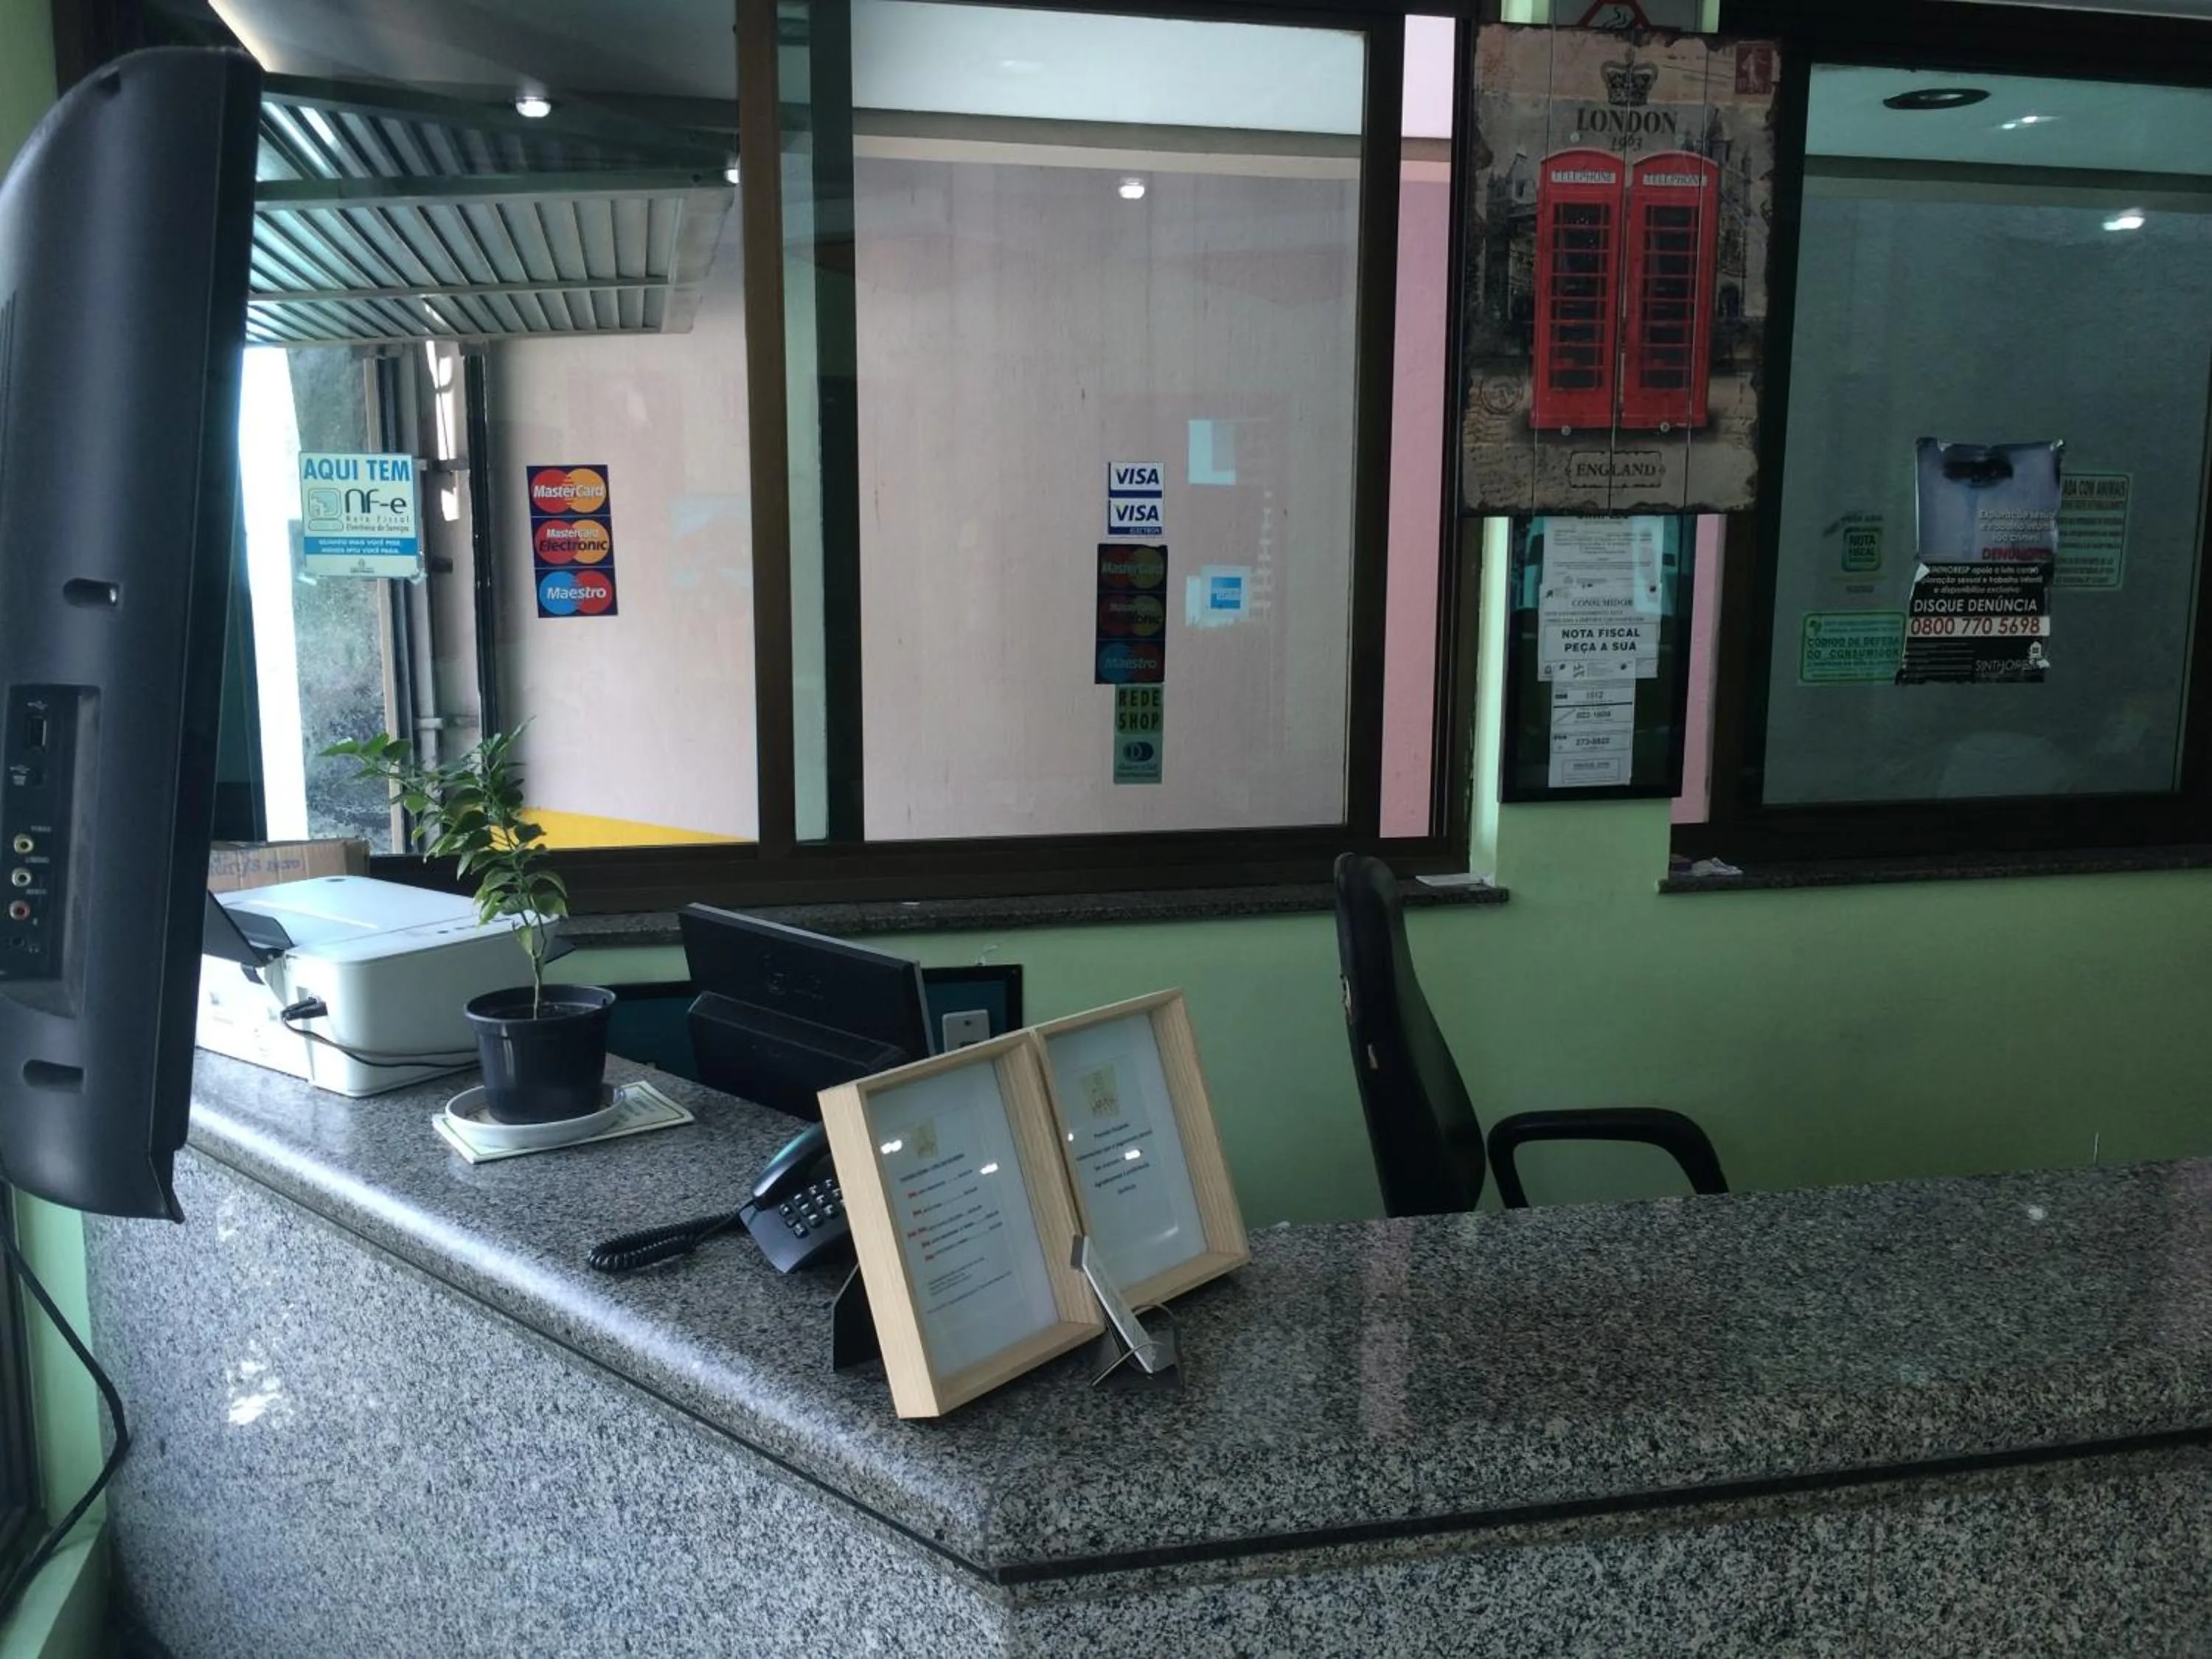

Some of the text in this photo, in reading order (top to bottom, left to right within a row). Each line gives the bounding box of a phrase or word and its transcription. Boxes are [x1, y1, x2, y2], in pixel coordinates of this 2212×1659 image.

[1576, 108, 1677, 135] LONDON
[1554, 171, 1612, 182] TELEPHONE
[303, 458, 411, 481] AQUI TEM
[1116, 468, 1160, 484] VISA
[1576, 462, 1656, 477] ENGLAND
[533, 484, 605, 499] MasterCard
[1116, 505, 1160, 521] VISA
[539, 538, 608, 552] Electronic
[546, 586, 607, 599] Maestro
[1914, 595, 2037, 614] DISQUE DENÚNCIA
[1561, 627, 1641, 639] NOTA FISCAL
[1911, 617, 1955, 635] 0800
[1962, 617, 1993, 635] 770
[1998, 616, 2040, 635] 5698
[1564, 641, 1637, 653] PEÇA A SUA
[1104, 658, 1157, 669] Maestro
[1119, 689, 1161, 706] REDE
[1119, 712, 1159, 730] SHOP
